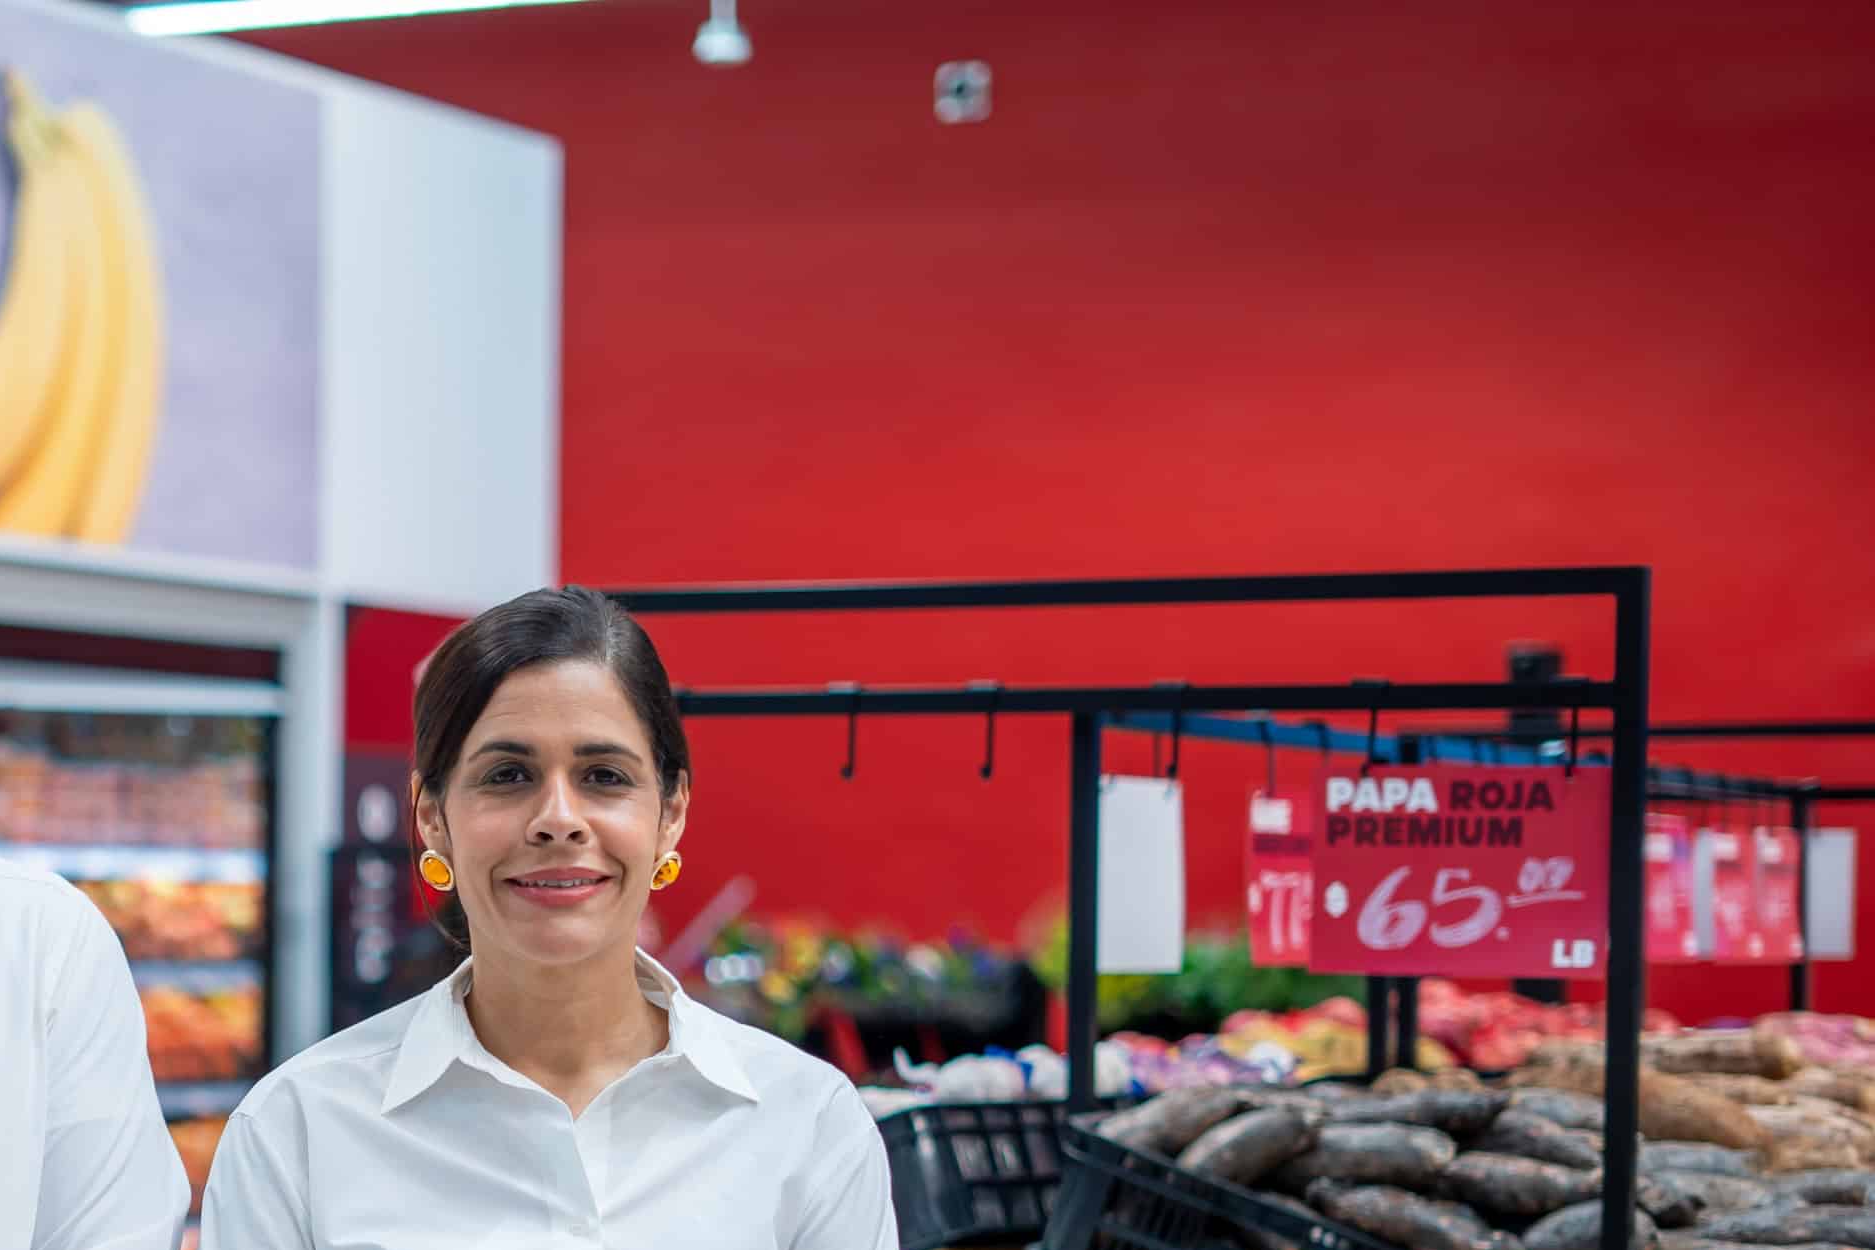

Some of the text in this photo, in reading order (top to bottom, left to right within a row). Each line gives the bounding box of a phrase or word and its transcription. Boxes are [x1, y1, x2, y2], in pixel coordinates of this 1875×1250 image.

[1326, 777, 1555, 813] PAPA ROJA
[1327, 816, 1524, 847] PREMIUM
[1551, 938, 1596, 969] LB
